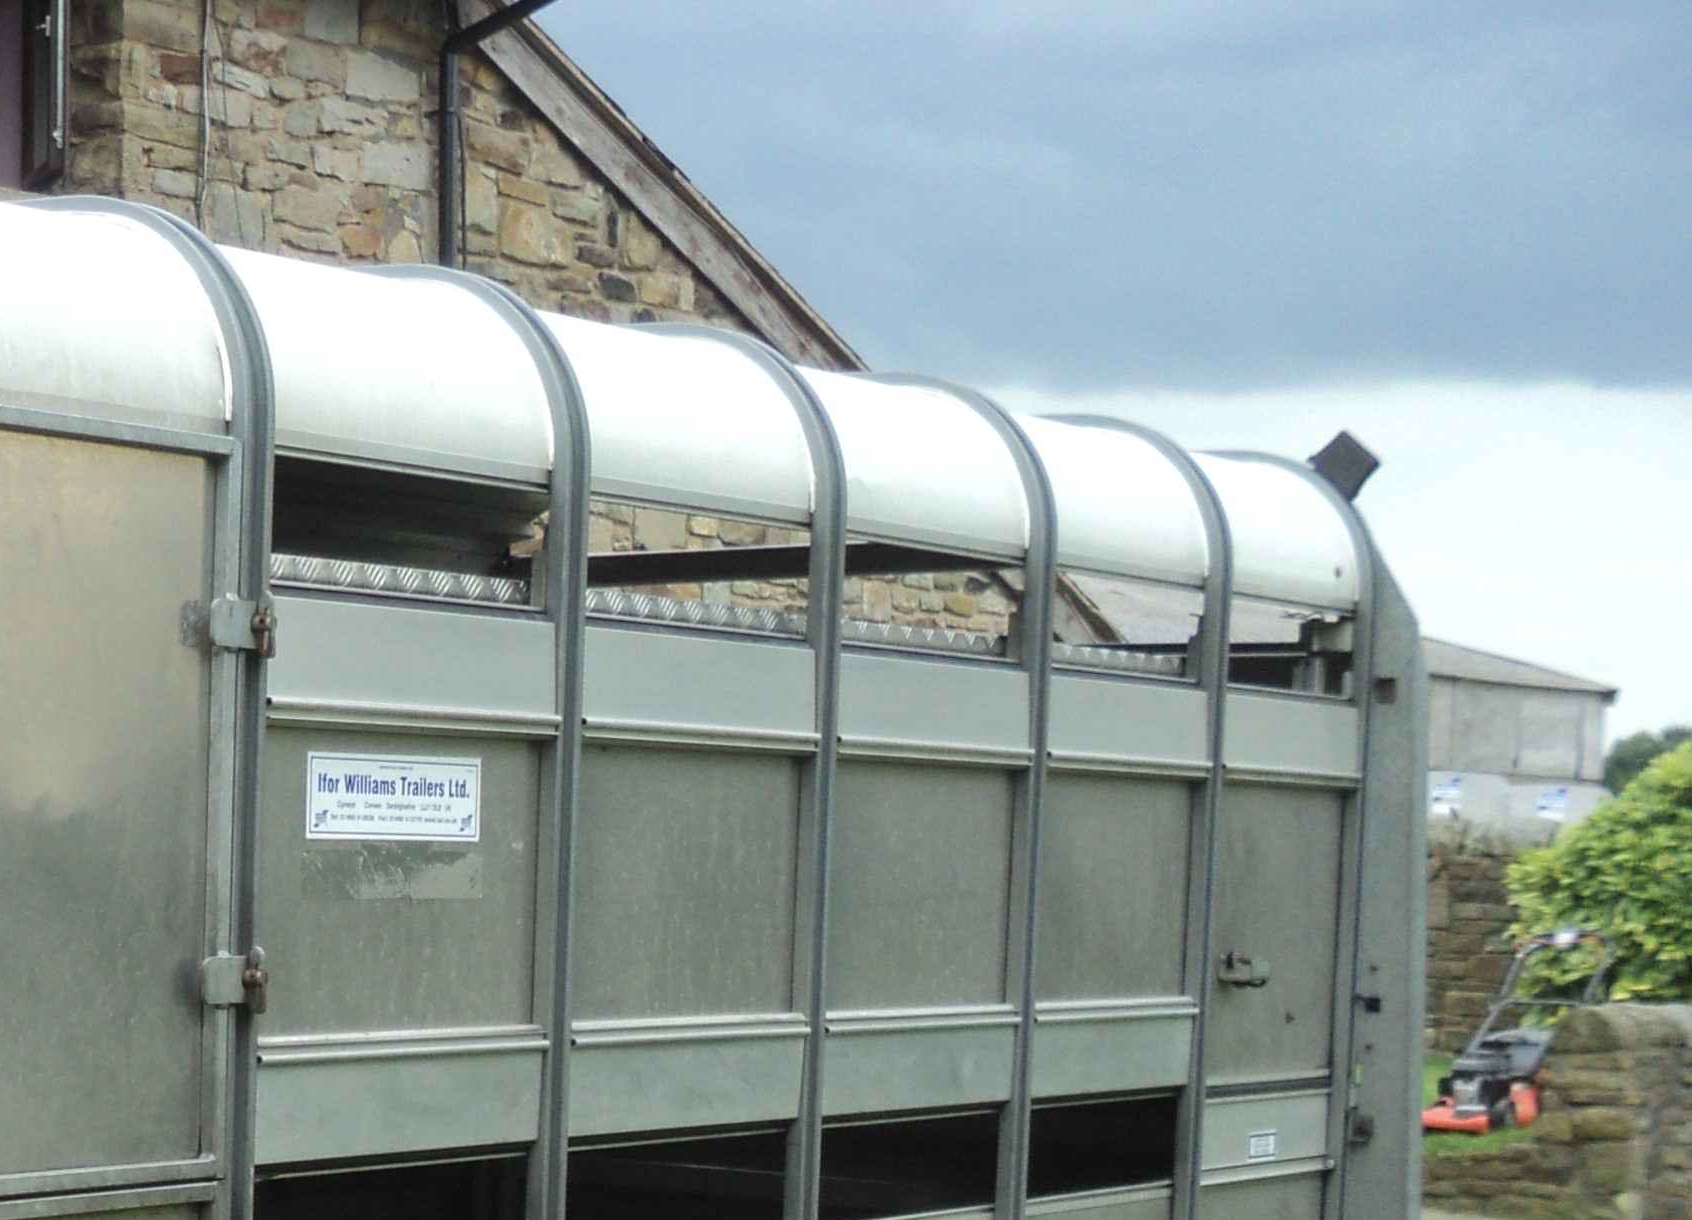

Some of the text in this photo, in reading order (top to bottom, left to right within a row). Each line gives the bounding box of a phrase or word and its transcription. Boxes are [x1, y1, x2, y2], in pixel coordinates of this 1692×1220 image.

[318, 772, 470, 799] Ifor Williams Trailers Ltd.
